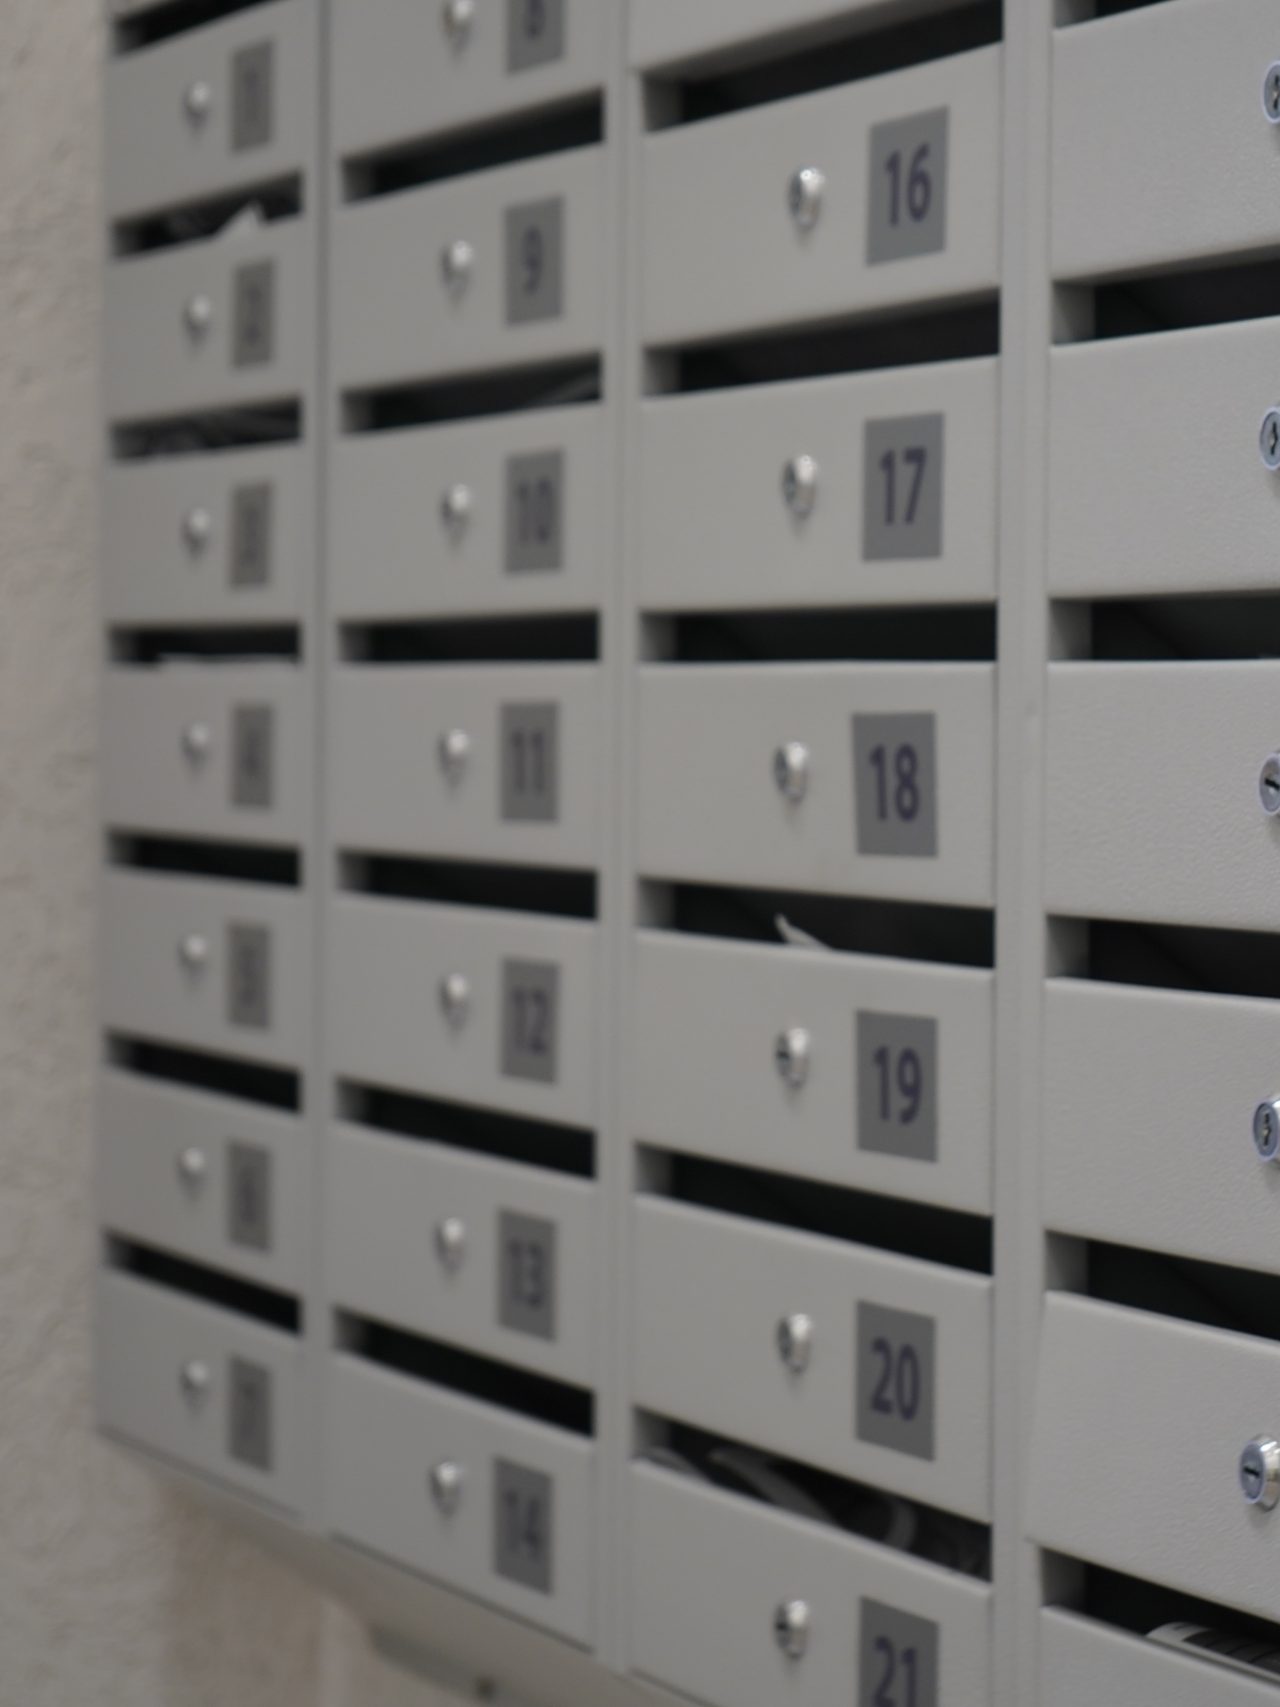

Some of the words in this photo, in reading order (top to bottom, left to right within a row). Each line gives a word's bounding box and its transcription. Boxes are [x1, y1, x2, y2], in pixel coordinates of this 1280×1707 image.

[886, 145, 931, 224] 16
[881, 448, 926, 523] 17
[511, 731, 544, 793] 11
[870, 745, 919, 821] 18
[514, 990, 547, 1054] 12
[874, 1047, 921, 1124] 19
[509, 1241, 545, 1309] 13
[871, 1338, 919, 1420] 20
[873, 1637, 916, 1707] 21
